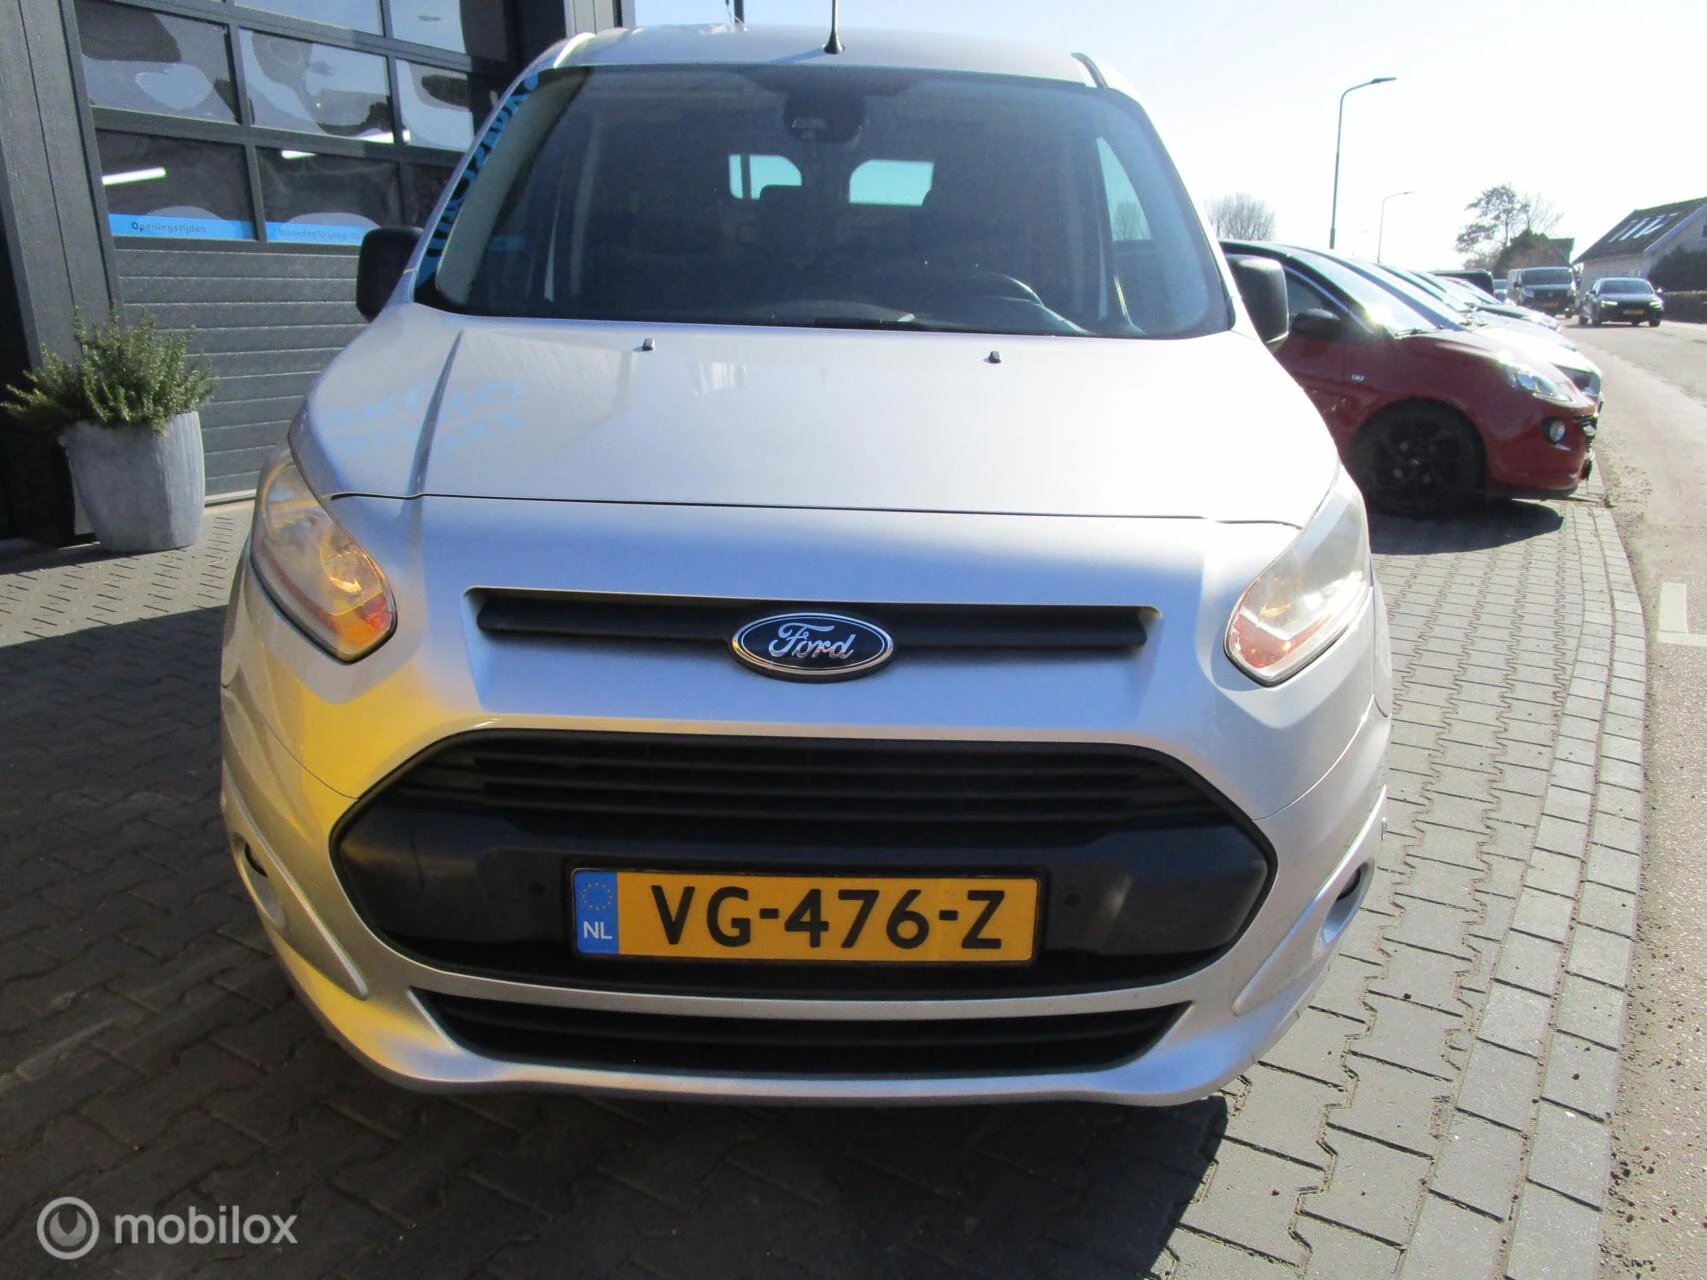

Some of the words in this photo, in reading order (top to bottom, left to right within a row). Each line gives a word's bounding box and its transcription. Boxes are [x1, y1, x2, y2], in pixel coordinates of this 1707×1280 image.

[131, 221, 207, 234] Openingstijden
[768, 622, 856, 660] Ford
[583, 921, 612, 940] NL
[650, 885, 1005, 949] VG-476-Z
